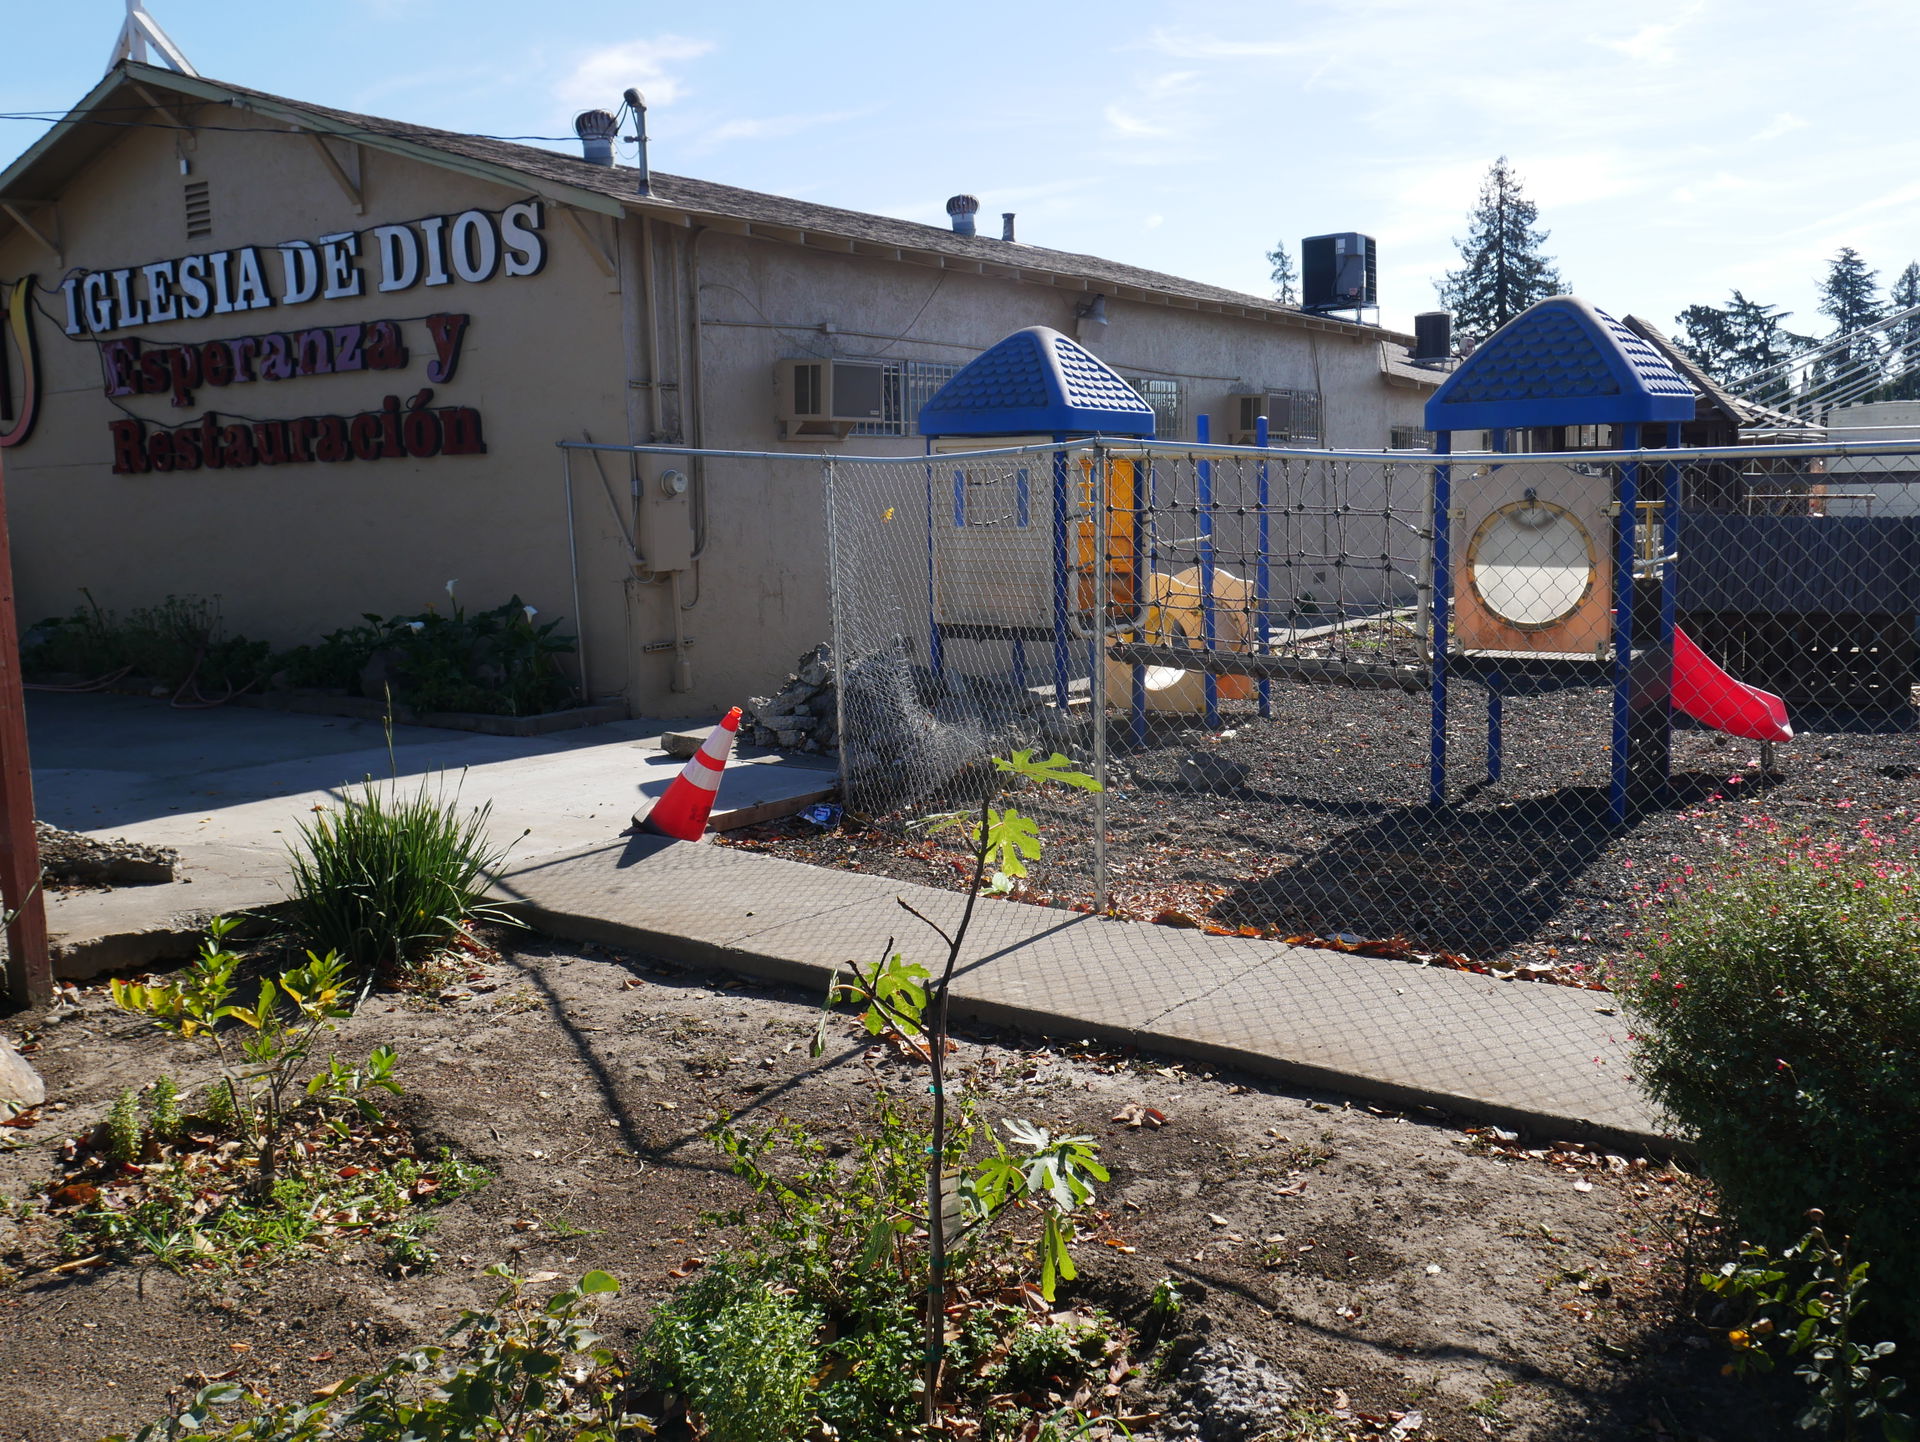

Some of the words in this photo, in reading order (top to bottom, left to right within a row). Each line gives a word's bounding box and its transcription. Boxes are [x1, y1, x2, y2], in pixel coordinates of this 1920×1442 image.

[62, 248, 274, 335] IGLESIA
[277, 231, 364, 305] DE
[374, 202, 547, 293] DIOS
[102, 322, 409, 407] Esperanza
[426, 314, 470, 384] y
[108, 388, 487, 475] Restauración
